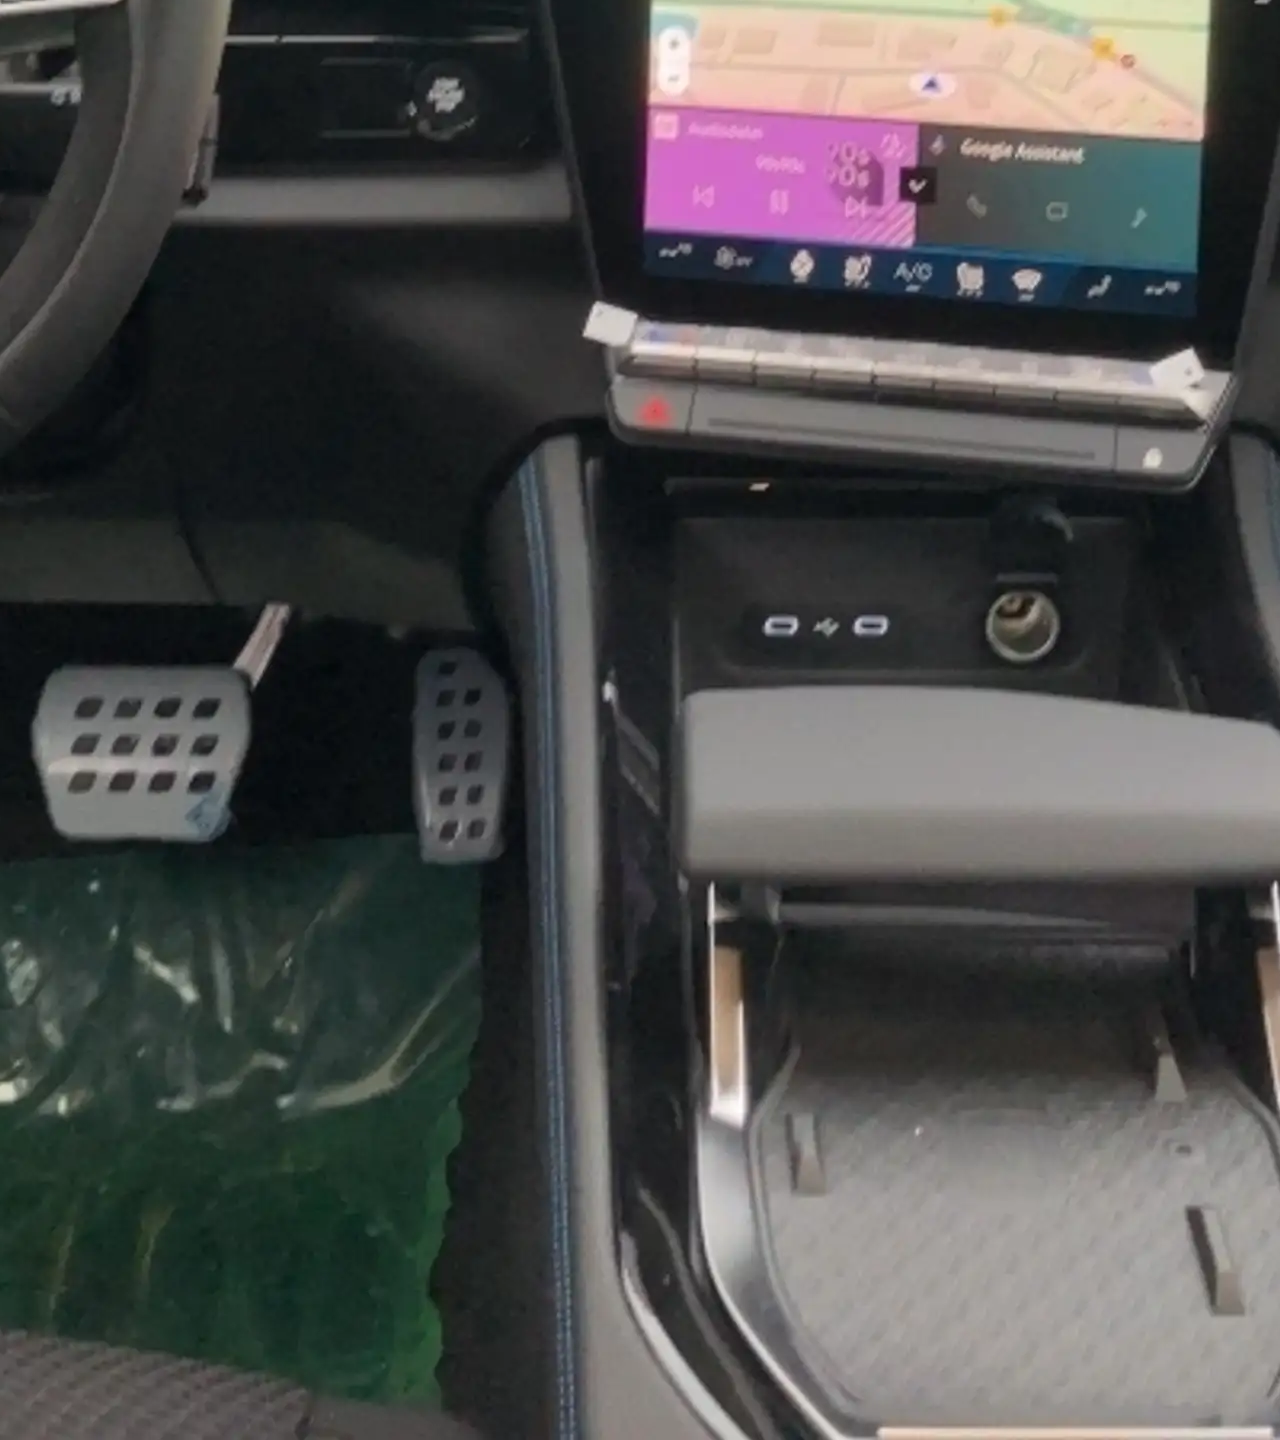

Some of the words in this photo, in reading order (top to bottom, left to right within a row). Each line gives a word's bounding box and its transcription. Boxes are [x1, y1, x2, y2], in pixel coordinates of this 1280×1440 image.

[960, 137, 1014, 163] Google
[1016, 141, 1086, 166] Assistant
[892, 260, 934, 283] A/C
